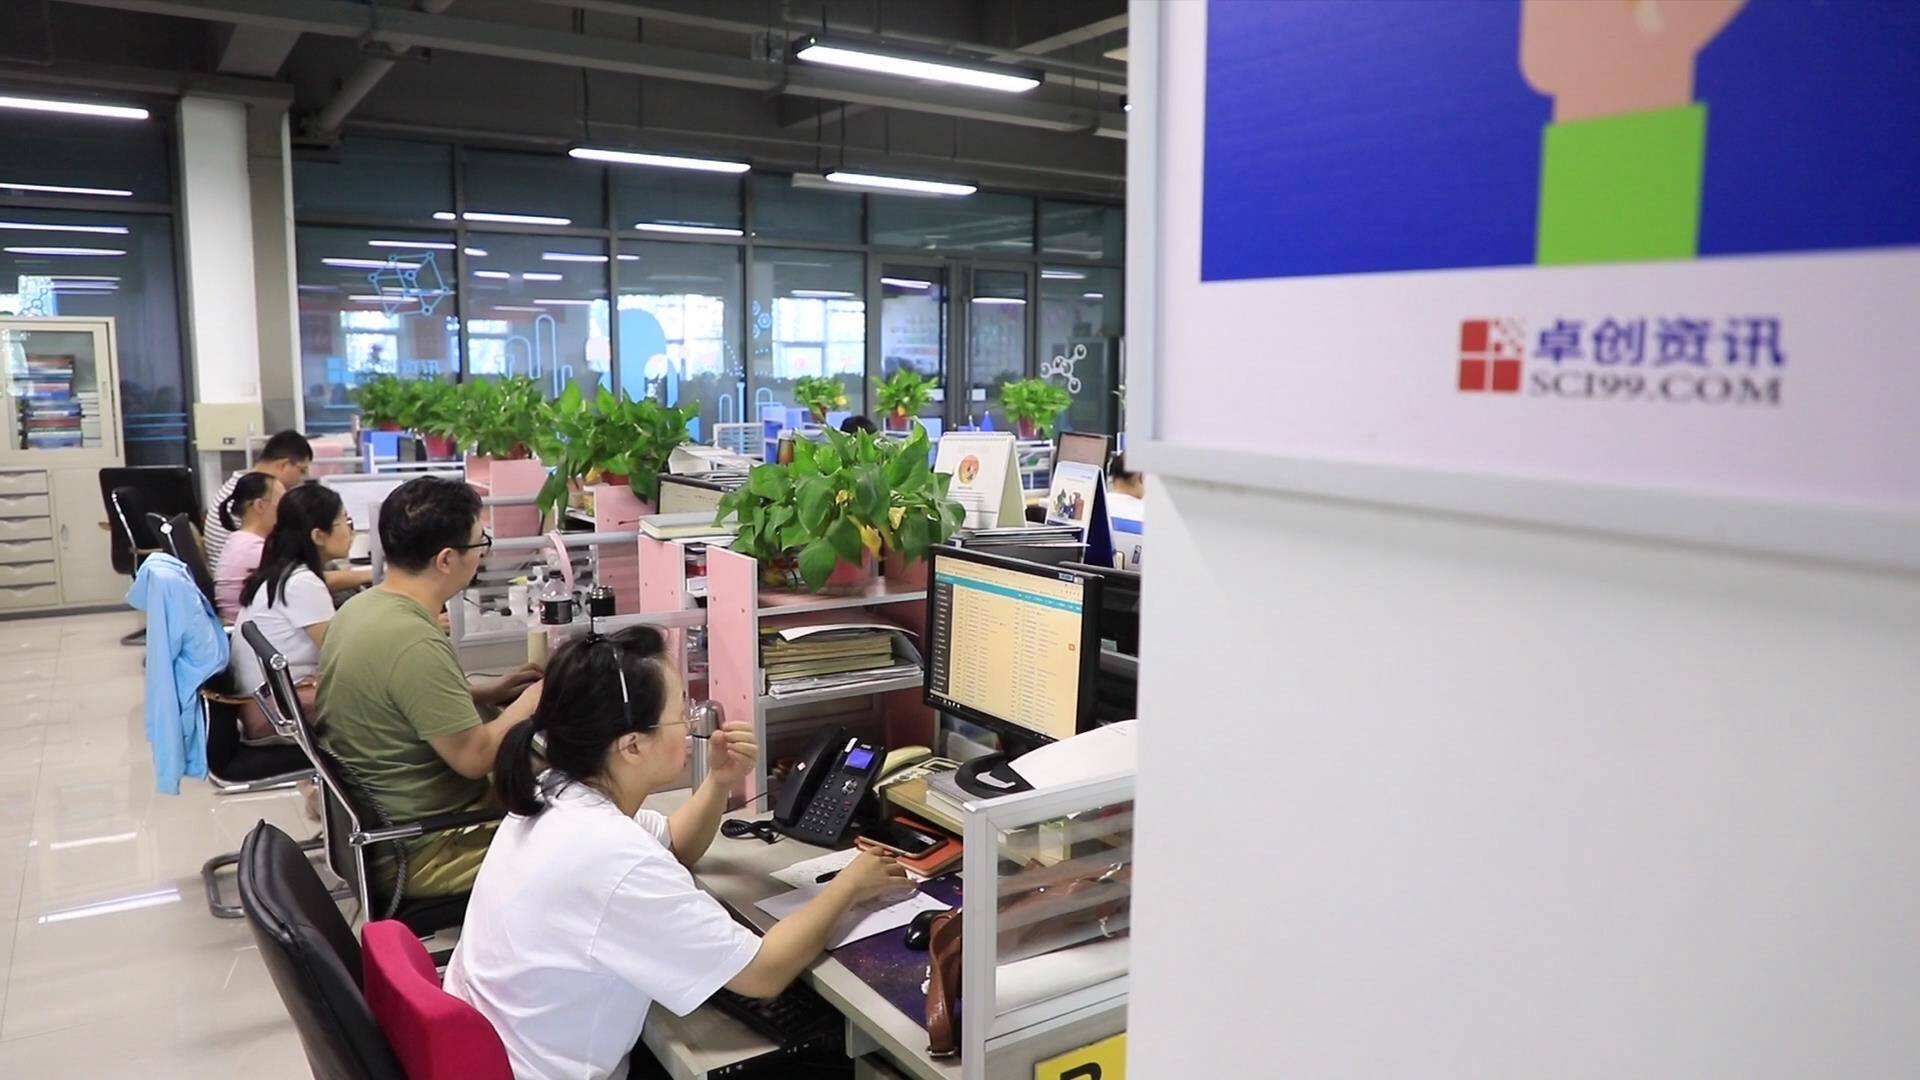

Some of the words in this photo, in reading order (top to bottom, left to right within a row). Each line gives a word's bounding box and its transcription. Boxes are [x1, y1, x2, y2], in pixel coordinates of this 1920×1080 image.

[1532, 317, 1786, 367] 卓创资讯
[1530, 372, 1782, 405] SCI99.COM
